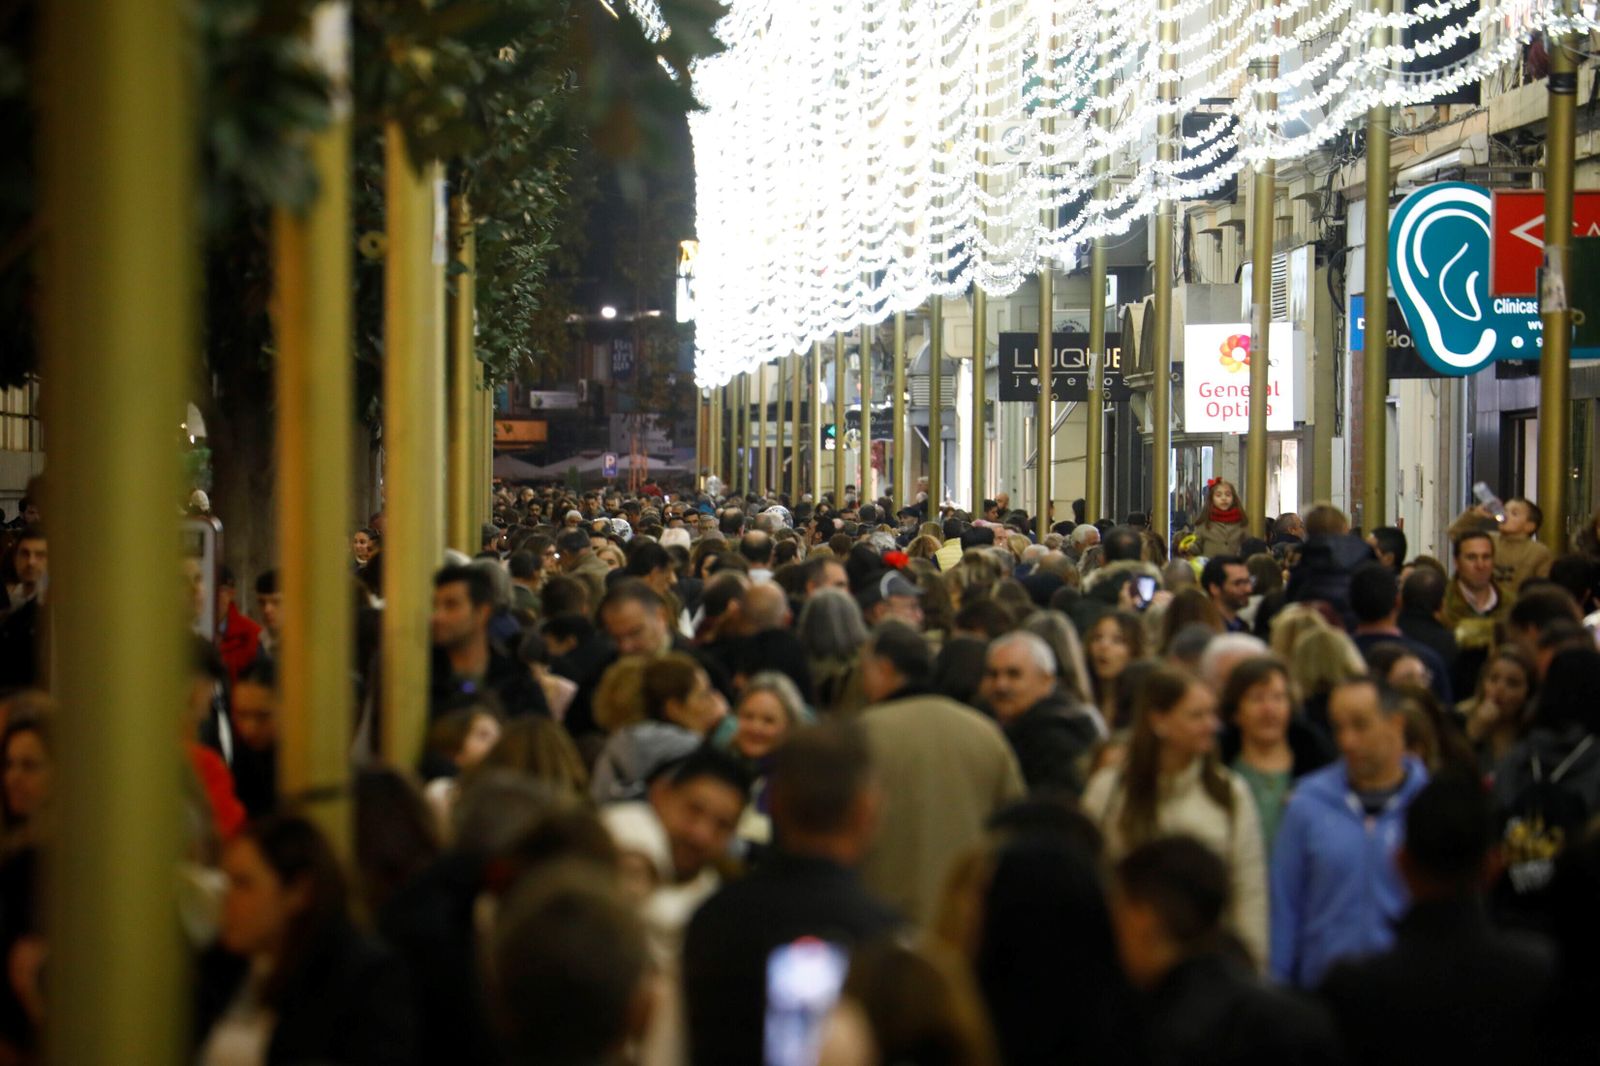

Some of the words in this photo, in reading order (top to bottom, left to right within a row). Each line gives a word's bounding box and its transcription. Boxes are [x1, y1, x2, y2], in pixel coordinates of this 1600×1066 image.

[1014, 348, 1121, 368] LUQUE
[1014, 376, 1131, 388] joyeos
[1199, 381, 1280, 398] Geneal
[1206, 401, 1272, 422] Optia
